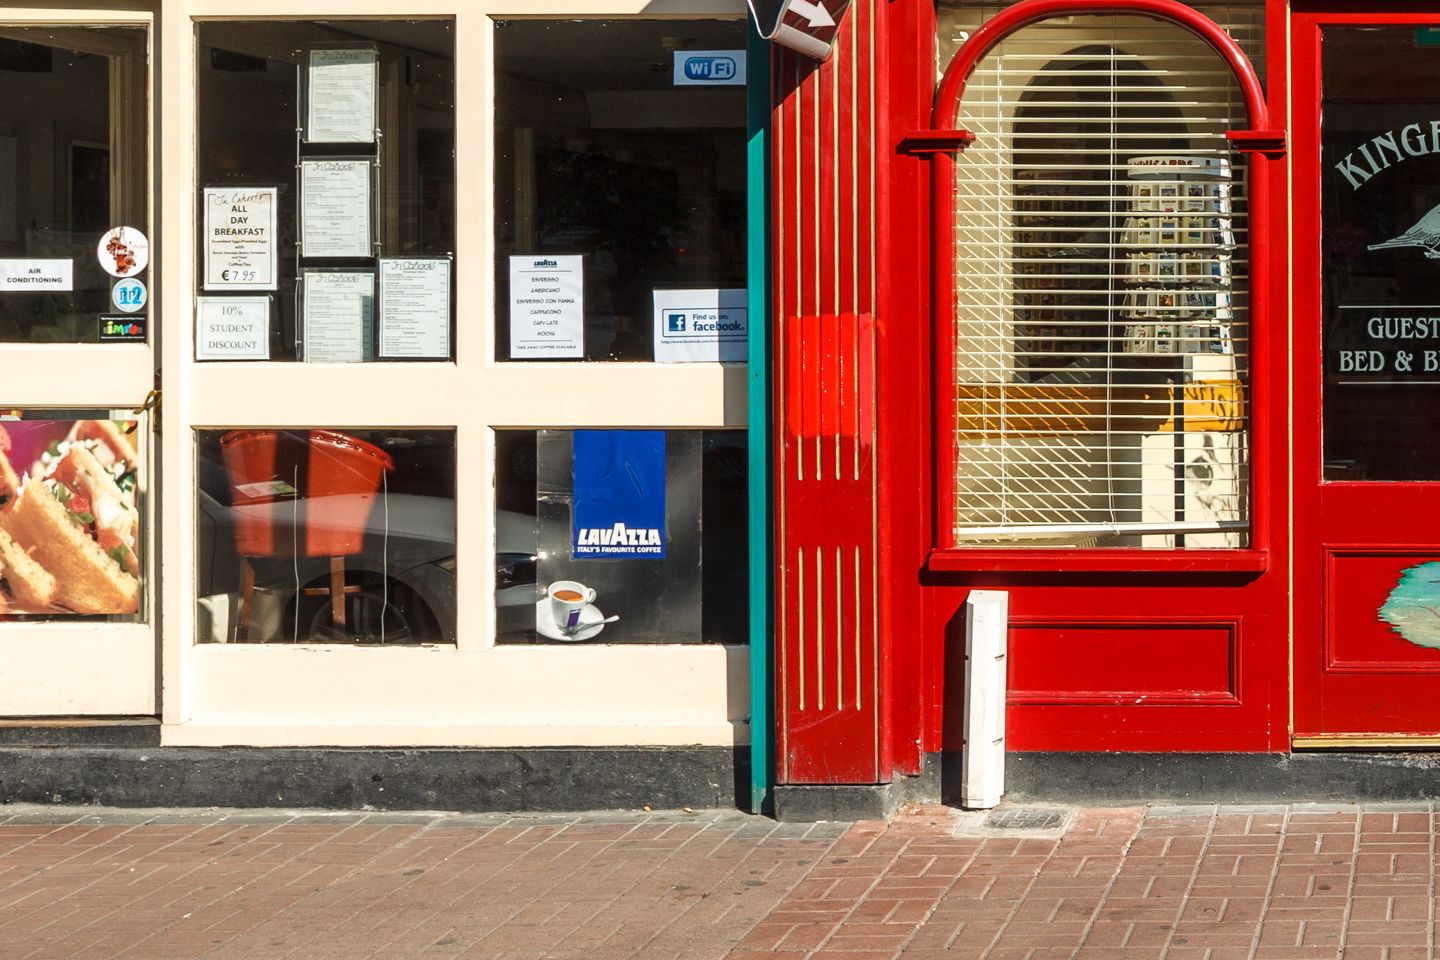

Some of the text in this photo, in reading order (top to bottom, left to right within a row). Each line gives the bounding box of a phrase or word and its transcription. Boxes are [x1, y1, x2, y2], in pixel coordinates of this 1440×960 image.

[231, 205, 248, 213] ALL
[230, 216, 248, 224] DAY
[214, 228, 265, 236] BREAKFAST
[222, 305, 243, 316] 10%
[209, 324, 255, 333] STUDENT
[208, 341, 257, 349] DISCOUNT
[1339, 350, 1385, 372] BED
[1394, 350, 1414, 372] &
[578, 523, 662, 546] LAVAZZA
[577, 546, 662, 554] ITALY'S FAVOURITE COFFEE
